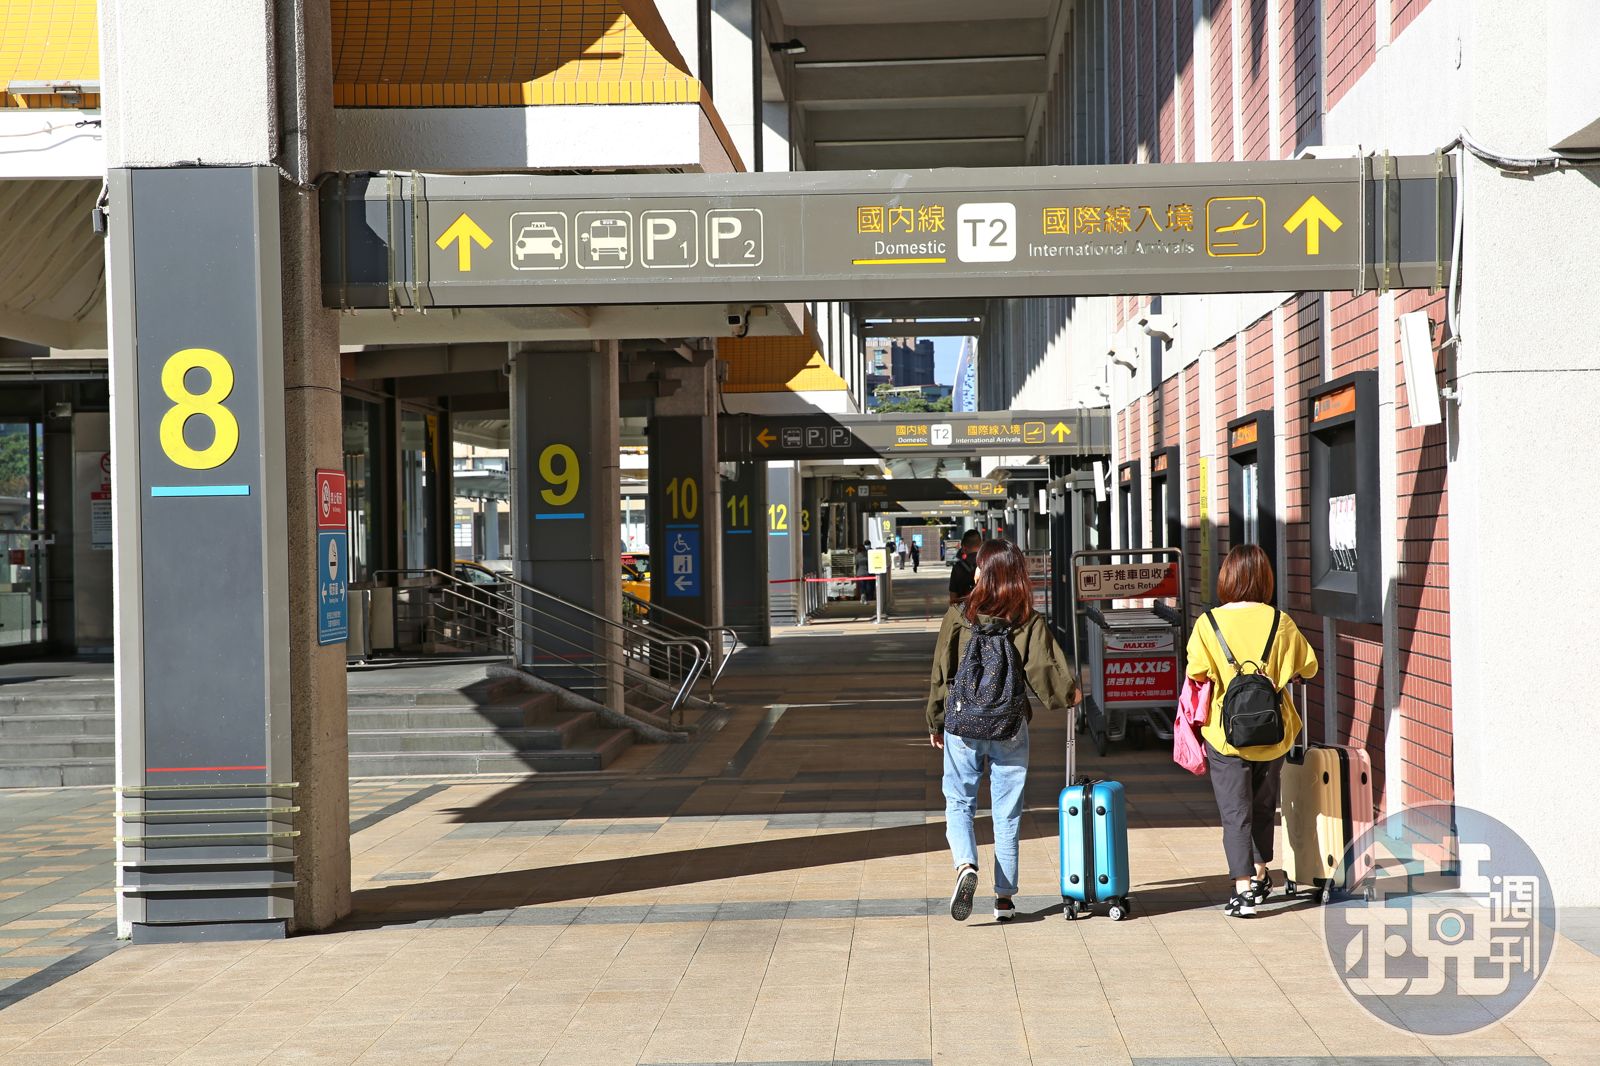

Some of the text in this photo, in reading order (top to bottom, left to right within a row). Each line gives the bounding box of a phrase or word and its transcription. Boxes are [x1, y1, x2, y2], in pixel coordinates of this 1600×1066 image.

[857, 204, 946, 234] 國內線
[1042, 203, 1195, 235] 國際線入境
[963, 218, 1008, 247] T2
[874, 239, 946, 255] Domestic
[1028, 239, 1195, 257] International Arrivals
[159, 347, 240, 471] 8
[896, 425, 928, 436] 國內線
[934, 428, 949, 440] T2
[967, 424, 1021, 436] 國際線入境
[898, 436, 928, 444] Domestic
[996, 435, 1021, 443] Arrivals
[539, 443, 580, 506] 9
[666, 477, 698, 520] 10
[727, 494, 749, 527] 11
[768, 503, 788, 530] 12
[801, 509, 810, 532] 3
[1103, 567, 1174, 582] 手推車回收處
[1113, 581, 1166, 591] Carts Return
[1123, 641, 1156, 649] MAXXIS
[1105, 661, 1171, 674] MAXXIS
